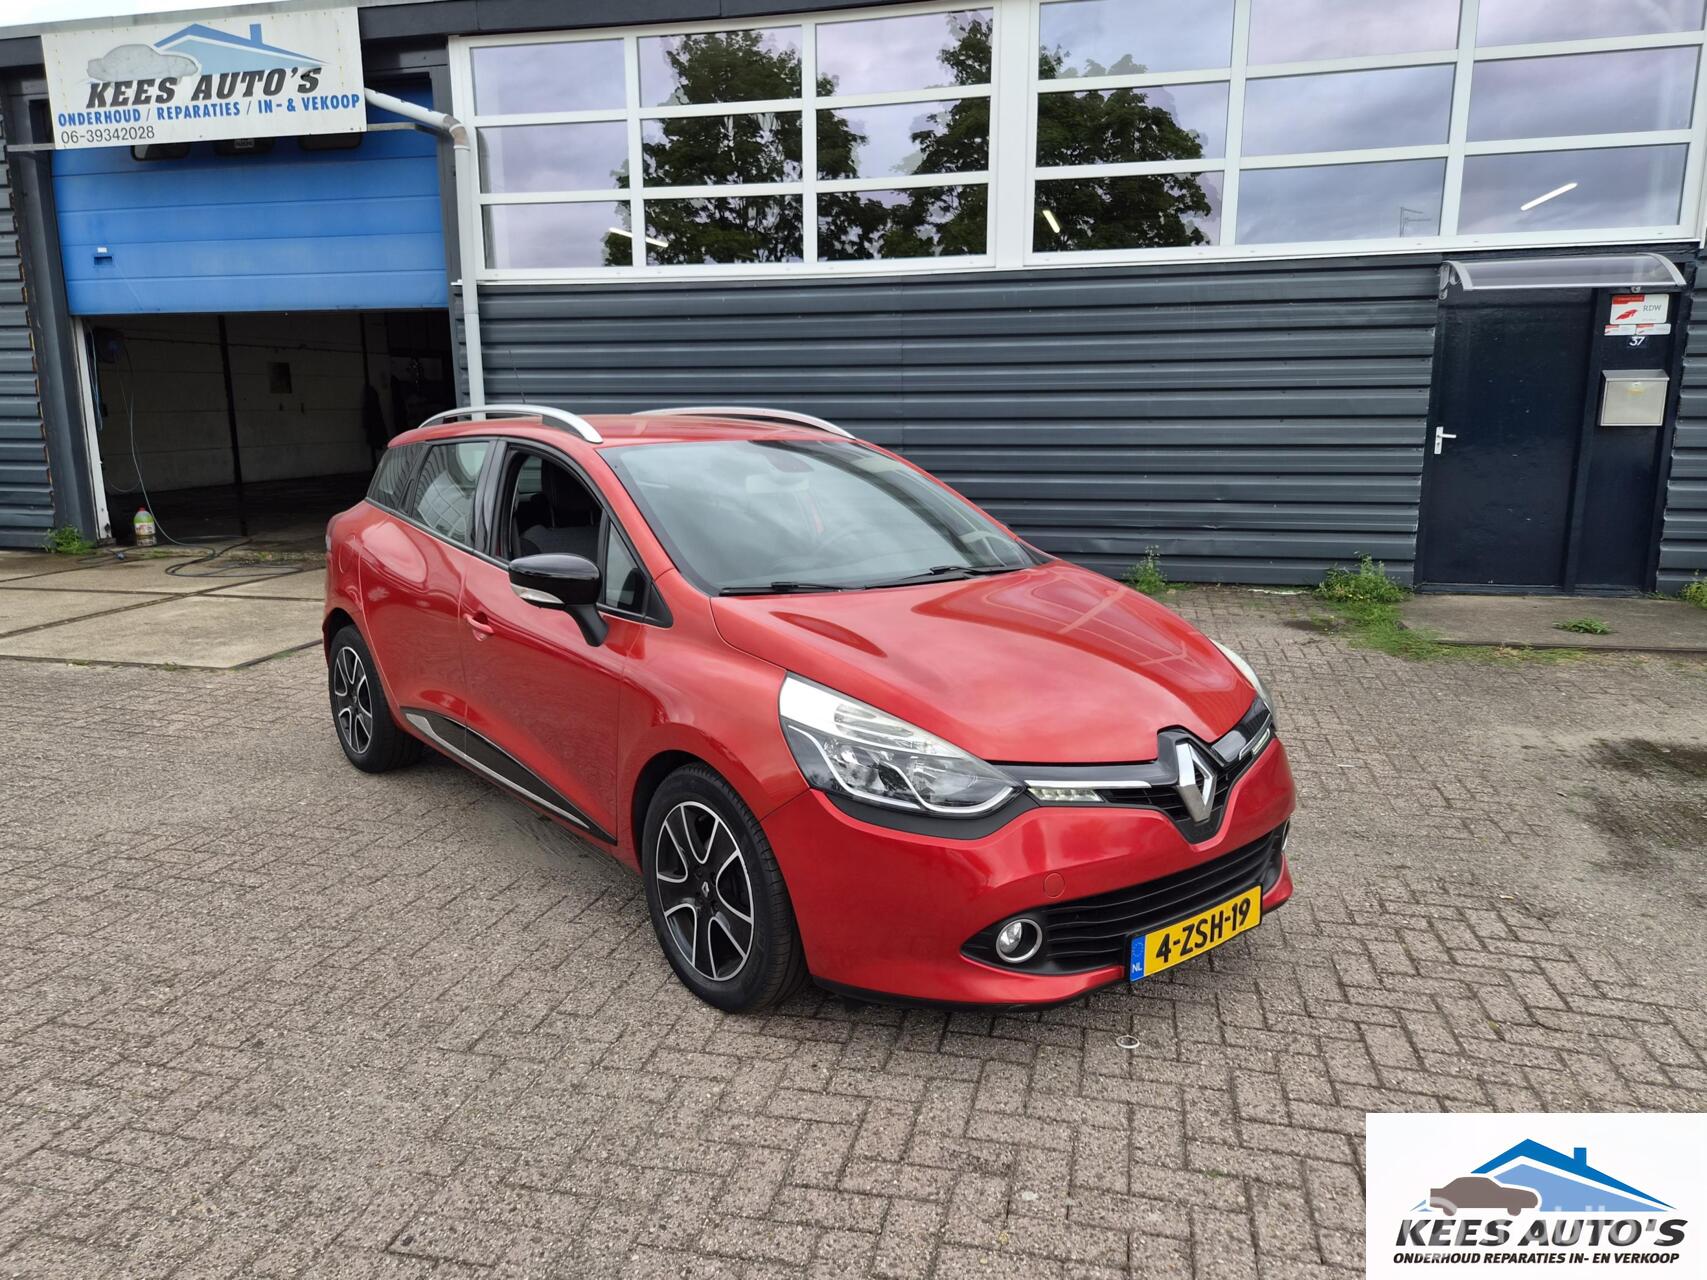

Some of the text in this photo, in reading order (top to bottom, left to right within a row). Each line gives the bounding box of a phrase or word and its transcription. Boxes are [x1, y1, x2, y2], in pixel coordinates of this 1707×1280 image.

[86, 66, 323, 109] KEES AUTO'S
[58, 107, 141, 127] ONDERHOUD
[157, 101, 241, 121] REPARATIES
[302, 94, 361, 111] VEKOOP
[60, 125, 155, 145] 06-39342028
[1643, 304, 1662, 312] RDW
[1629, 336, 1645, 346] 37
[1155, 897, 1251, 963] 4-ZSH-19
[1132, 962, 1142, 973] NL
